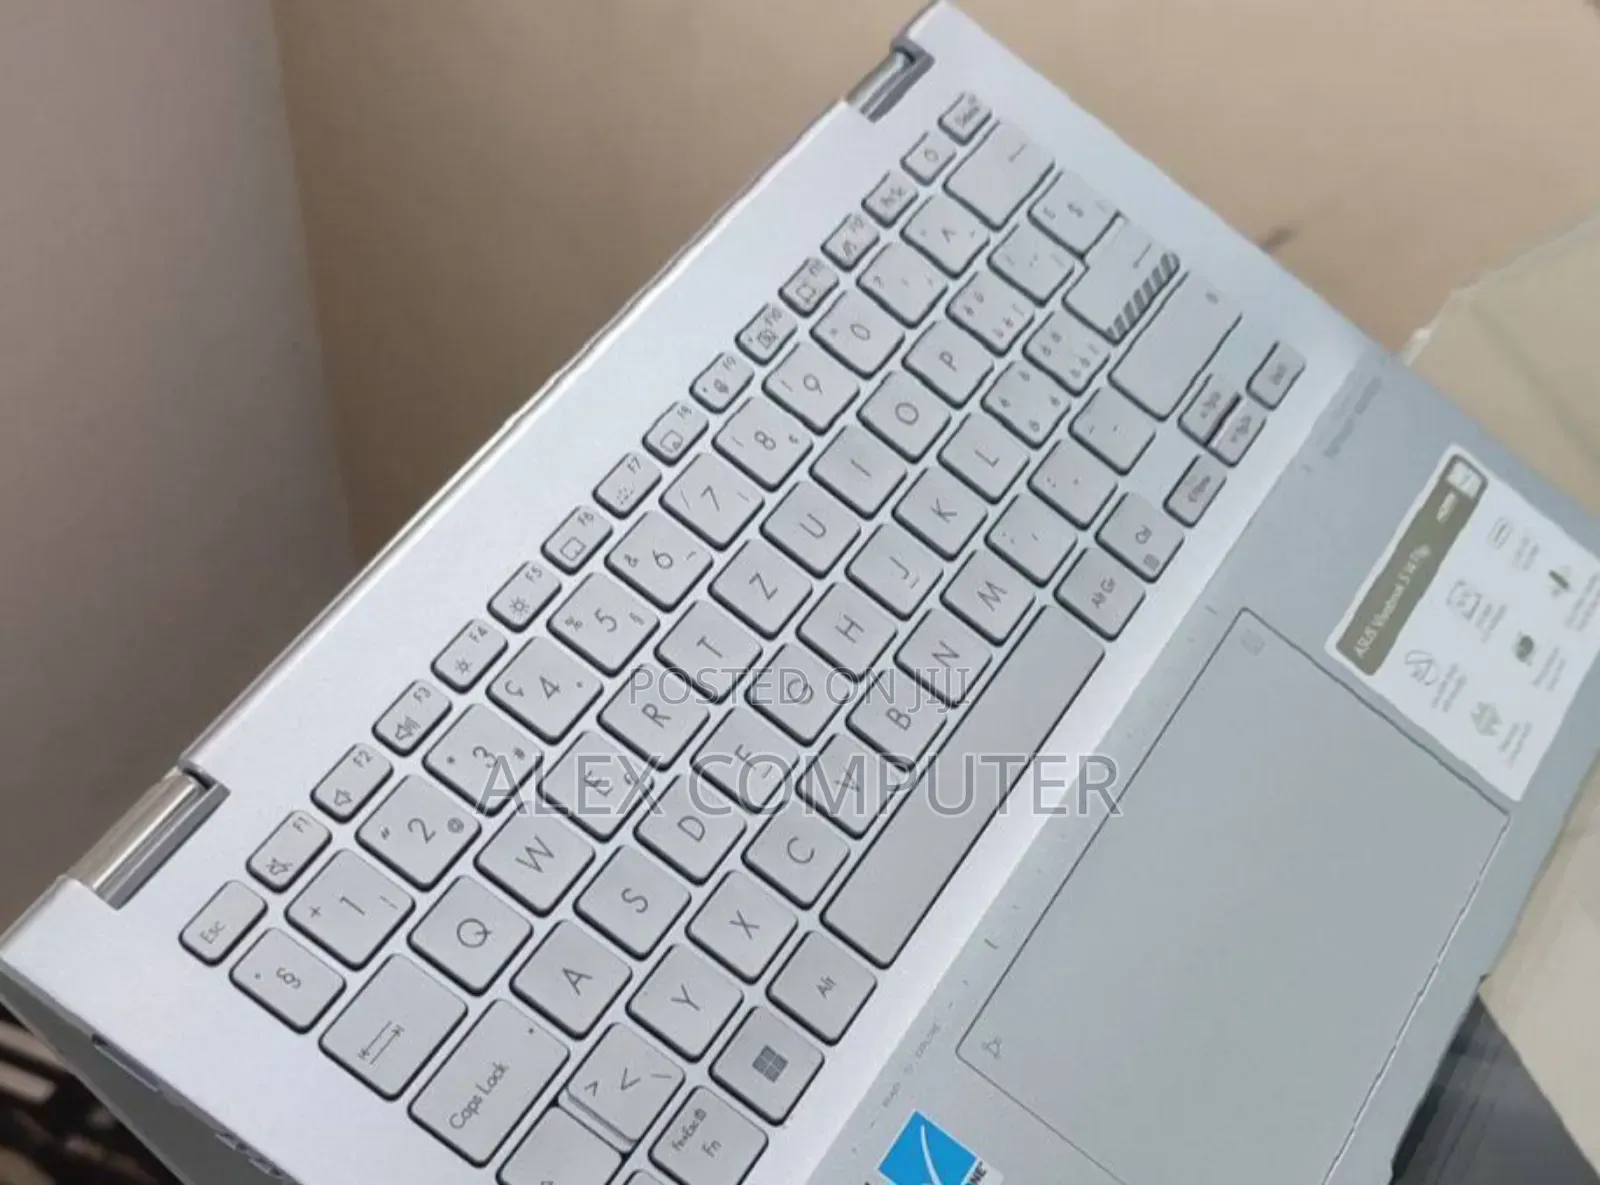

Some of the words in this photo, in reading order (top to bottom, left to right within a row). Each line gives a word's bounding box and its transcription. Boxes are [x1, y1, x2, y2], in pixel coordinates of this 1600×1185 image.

[939, 351, 957, 372] P
[803, 374, 823, 396] 9
[895, 402, 919, 426] O
[753, 431, 776, 450] 8
[627, 457, 642, 474] F7
[975, 450, 999, 468] L
[700, 486, 720, 512] 7
[931, 498, 958, 524] K
[577, 512, 594, 527] F6
[800, 513, 826, 538] U
[652, 548, 673, 569] 6
[890, 556, 909, 579] J
[525, 567, 542, 583] F5
[749, 573, 778, 600] Z
[977, 580, 1008, 612] M
[594, 608, 617, 632] 5
[835, 614, 865, 643] H
[469, 626, 488, 643] F4
[697, 635, 722, 658] T
[932, 640, 960, 667] N
[413, 686, 432, 702] F3
[539, 675, 560, 699] 4
[642, 703, 672, 728] R
[886, 707, 912, 731] B
[353, 750, 373, 767] F2
[472, 746, 498, 768] 3
[735, 744, 757, 771] F
[292, 816, 310, 833] F1
[407, 817, 436, 843] 2
[677, 816, 706, 842] D
[515, 836, 555, 873] W
[787, 836, 815, 864] C
[340, 896, 365, 916] 1
[621, 888, 649, 913] S
[457, 918, 493, 948] Q
[729, 909, 761, 940] X
[561, 967, 593, 996] A
[816, 976, 837, 998] Alt
[671, 984, 700, 1011] Y
[449, 1094, 484, 1130] Caps
[476, 1062, 509, 1095] Lock
